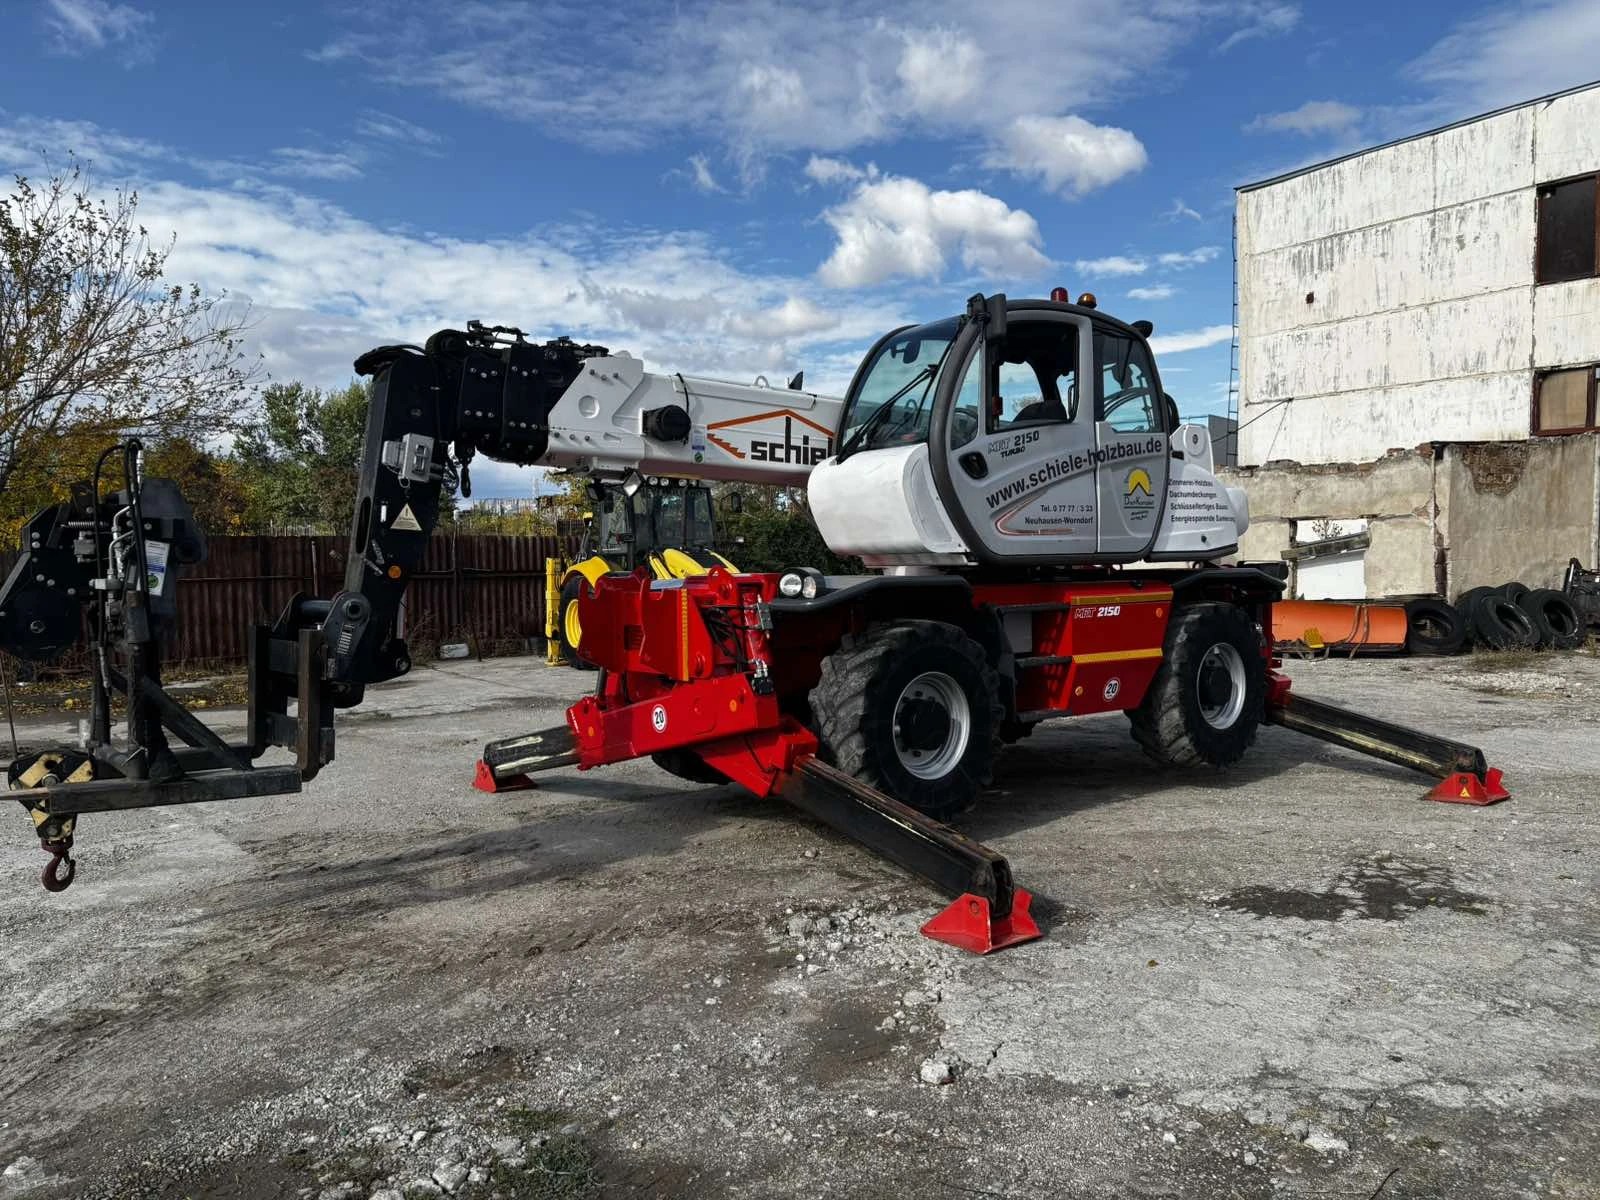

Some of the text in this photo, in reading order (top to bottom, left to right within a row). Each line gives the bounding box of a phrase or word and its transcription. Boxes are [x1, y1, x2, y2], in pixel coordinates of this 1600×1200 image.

[1014, 430, 1040, 447] 2150
[1000, 446, 1026, 458] TURBO
[986, 437, 1162, 508] www.schiele-holzbau.de
[1097, 606, 1120, 617] 2150
[1106, 683, 1118, 694] 20
[654, 710, 665, 725] 20
